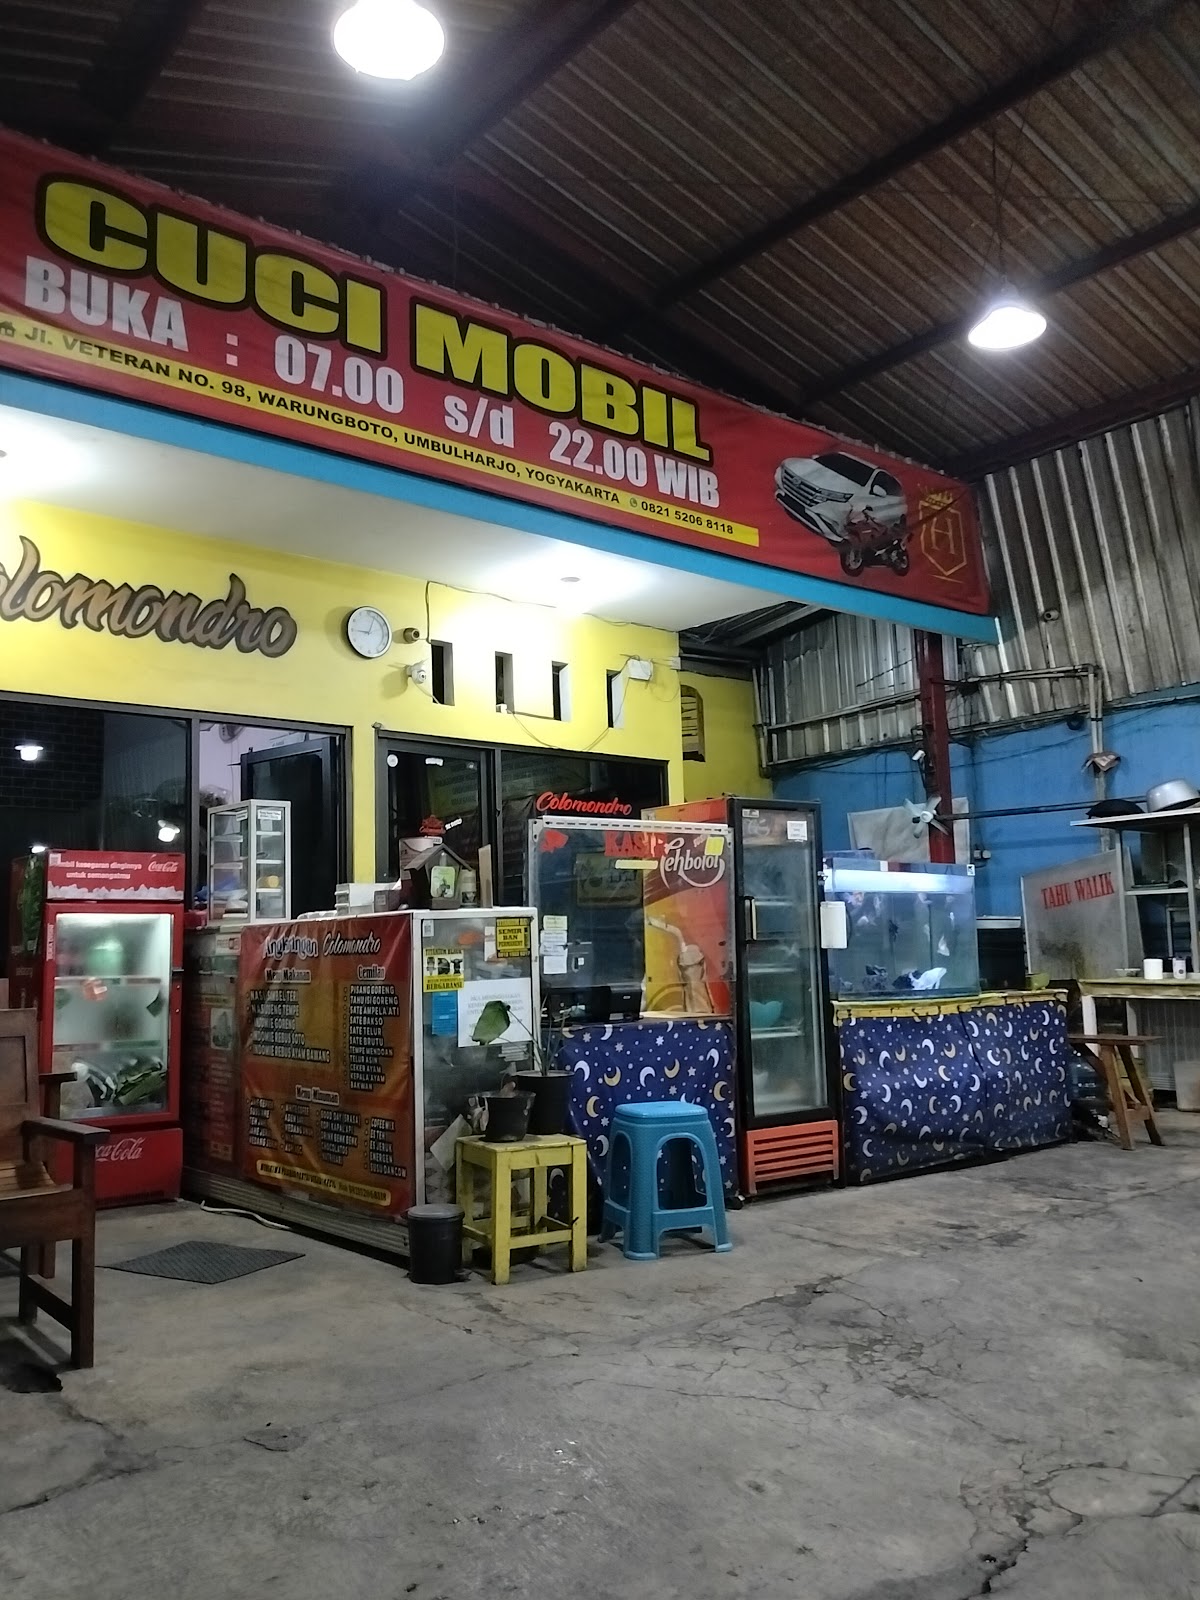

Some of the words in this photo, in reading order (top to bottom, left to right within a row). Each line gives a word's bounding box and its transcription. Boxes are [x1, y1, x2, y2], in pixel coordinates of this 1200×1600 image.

[24, 254, 189, 353] BUKA
[274, 335, 405, 415] 07.00
[443, 394, 515, 449] s/d
[548, 421, 648, 488] 22.00
[653, 454, 721, 509] WIB
[38, 174, 385, 358] CUCI
[411, 298, 713, 464] MOBIL
[62, 335, 171, 378] VETERAN
[178, 368, 215, 394] NO.
[221, 381, 252, 403] 98,
[257, 390, 399, 443] WARUNGBOTO,
[403, 433, 521, 479] UMBULHARJO,
[525, 467, 620, 504] YOGYAKARTA
[641, 501, 670, 518] 0821
[674, 511, 703, 528] 5206
[706, 519, 734, 535] 8118
[0, 535, 297, 658] lomondro
[536, 790, 634, 816] Colomondro
[1040, 882, 1073, 910] TAHU
[1074, 872, 1115, 902] WALIK
